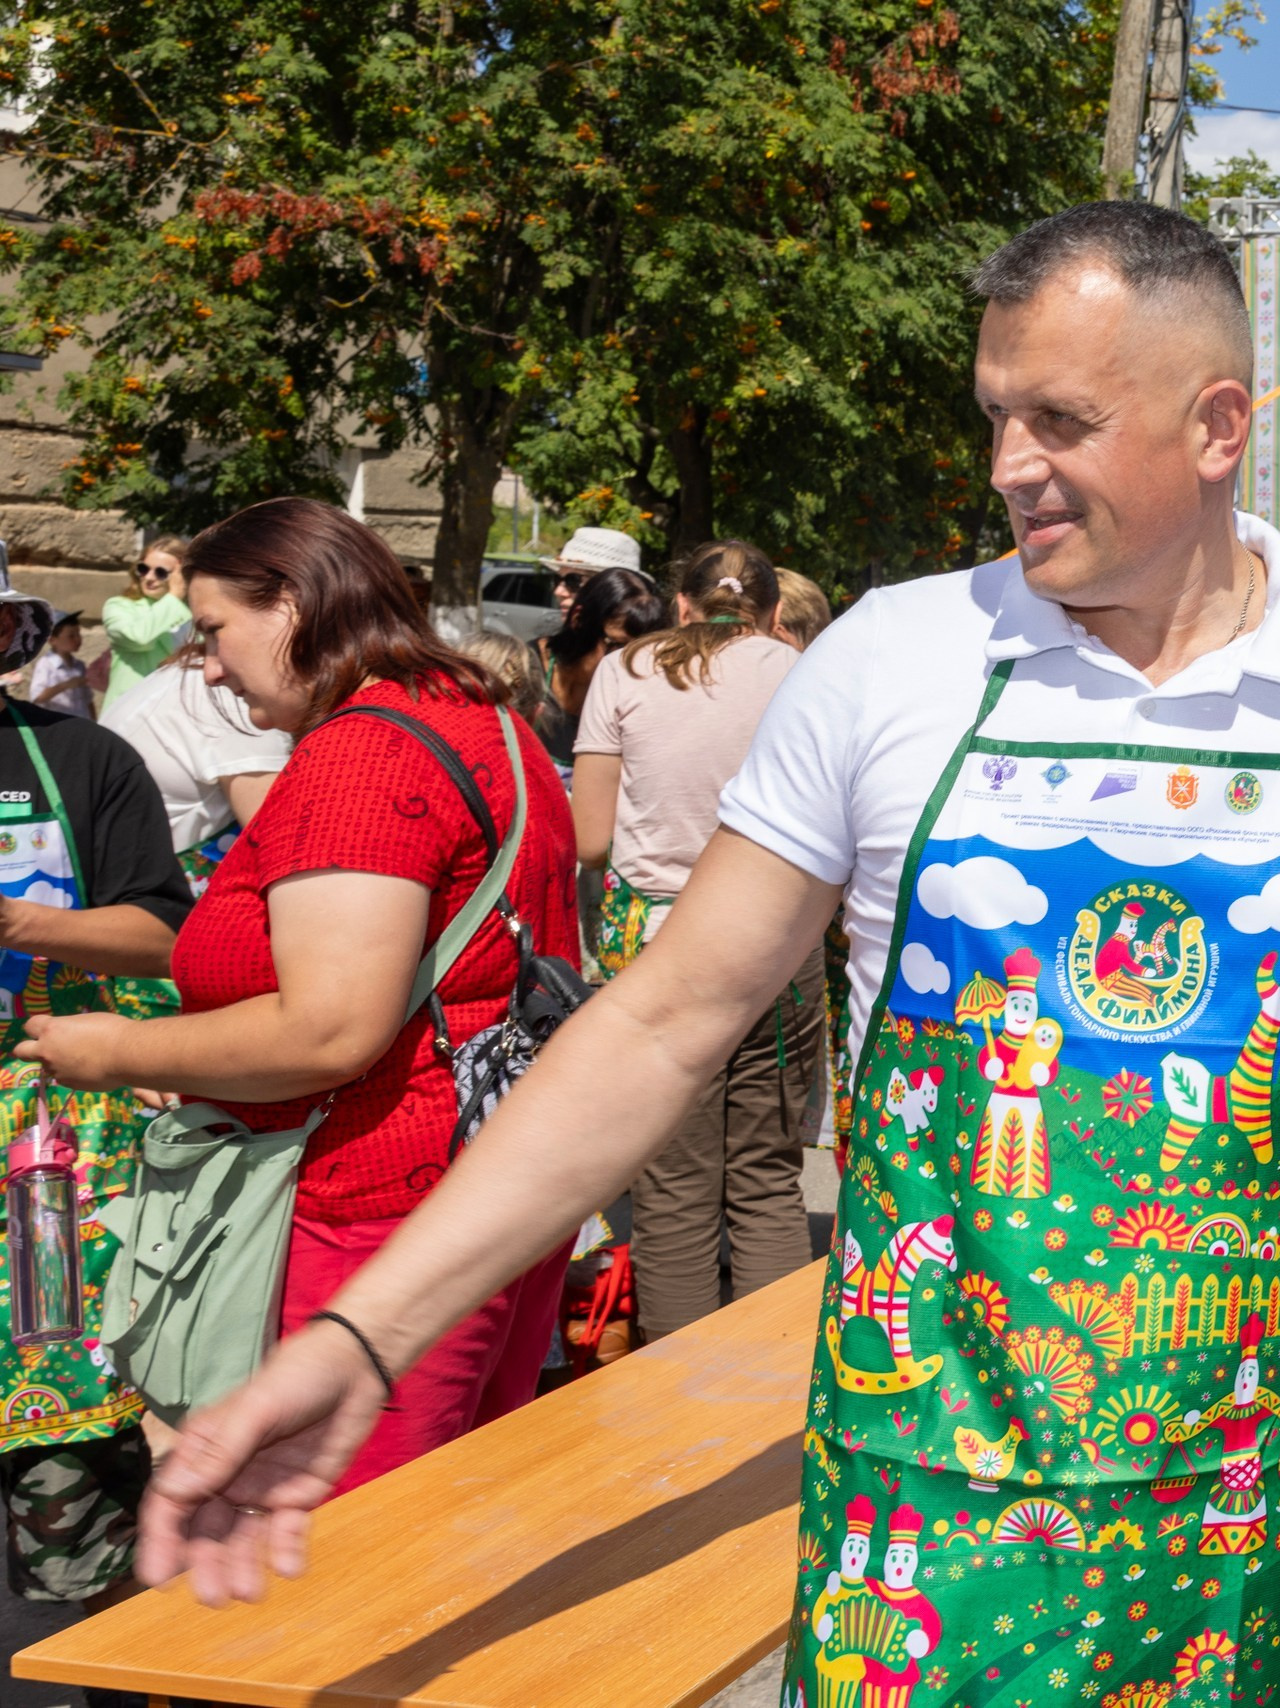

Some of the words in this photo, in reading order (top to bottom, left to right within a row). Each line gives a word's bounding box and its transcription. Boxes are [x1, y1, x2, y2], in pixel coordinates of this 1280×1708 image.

[1094, 884, 1188, 916] СКАЗКИ
[1055, 951, 1071, 1008] ФЕСТИВАЛЬ
[1067, 1004, 1119, 1042] ГОНЧАРНОГО
[1121, 1029, 1173, 1044] ИСКУССТВА
[1180, 988, 1214, 1032] ГЛИНЯНОЙ
[1208, 942, 1221, 988] ИГРУШКИ
[1074, 934, 1096, 1000] ДЕДА
[1097, 942, 1202, 1025] ФИЛИМОНА
